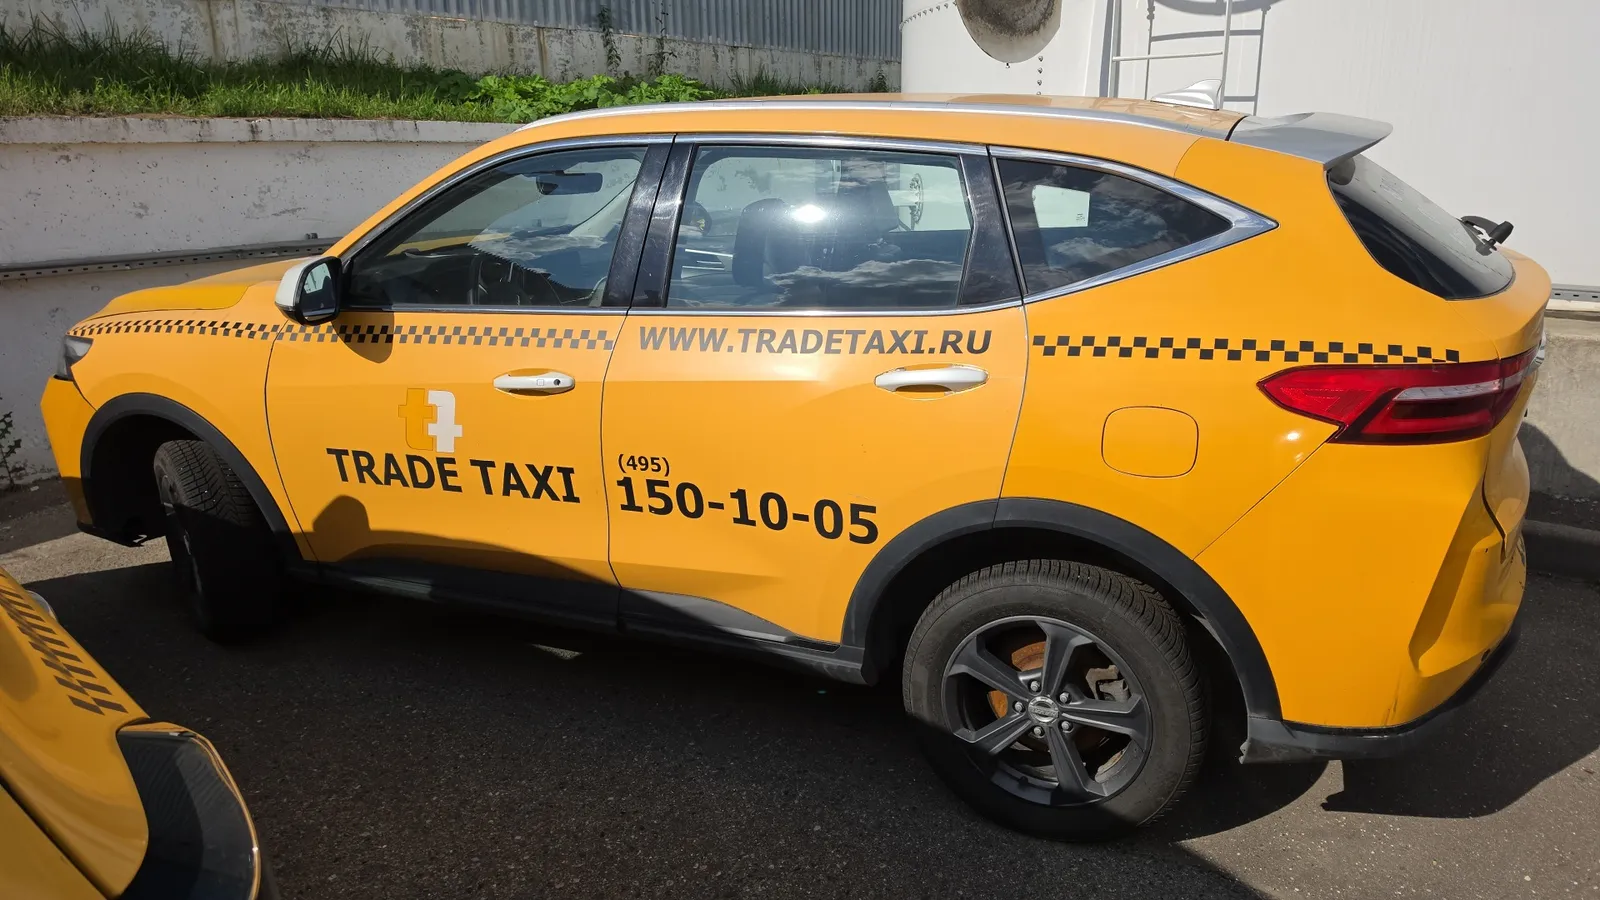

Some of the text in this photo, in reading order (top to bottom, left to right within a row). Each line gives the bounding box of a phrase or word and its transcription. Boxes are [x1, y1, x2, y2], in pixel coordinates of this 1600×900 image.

[639, 326, 992, 355] WWW.TRADETAXI.RU
[326, 448, 581, 503] TRADE TAXI
[618, 454, 670, 477] (495)
[616, 476, 879, 545] 150-10-05
